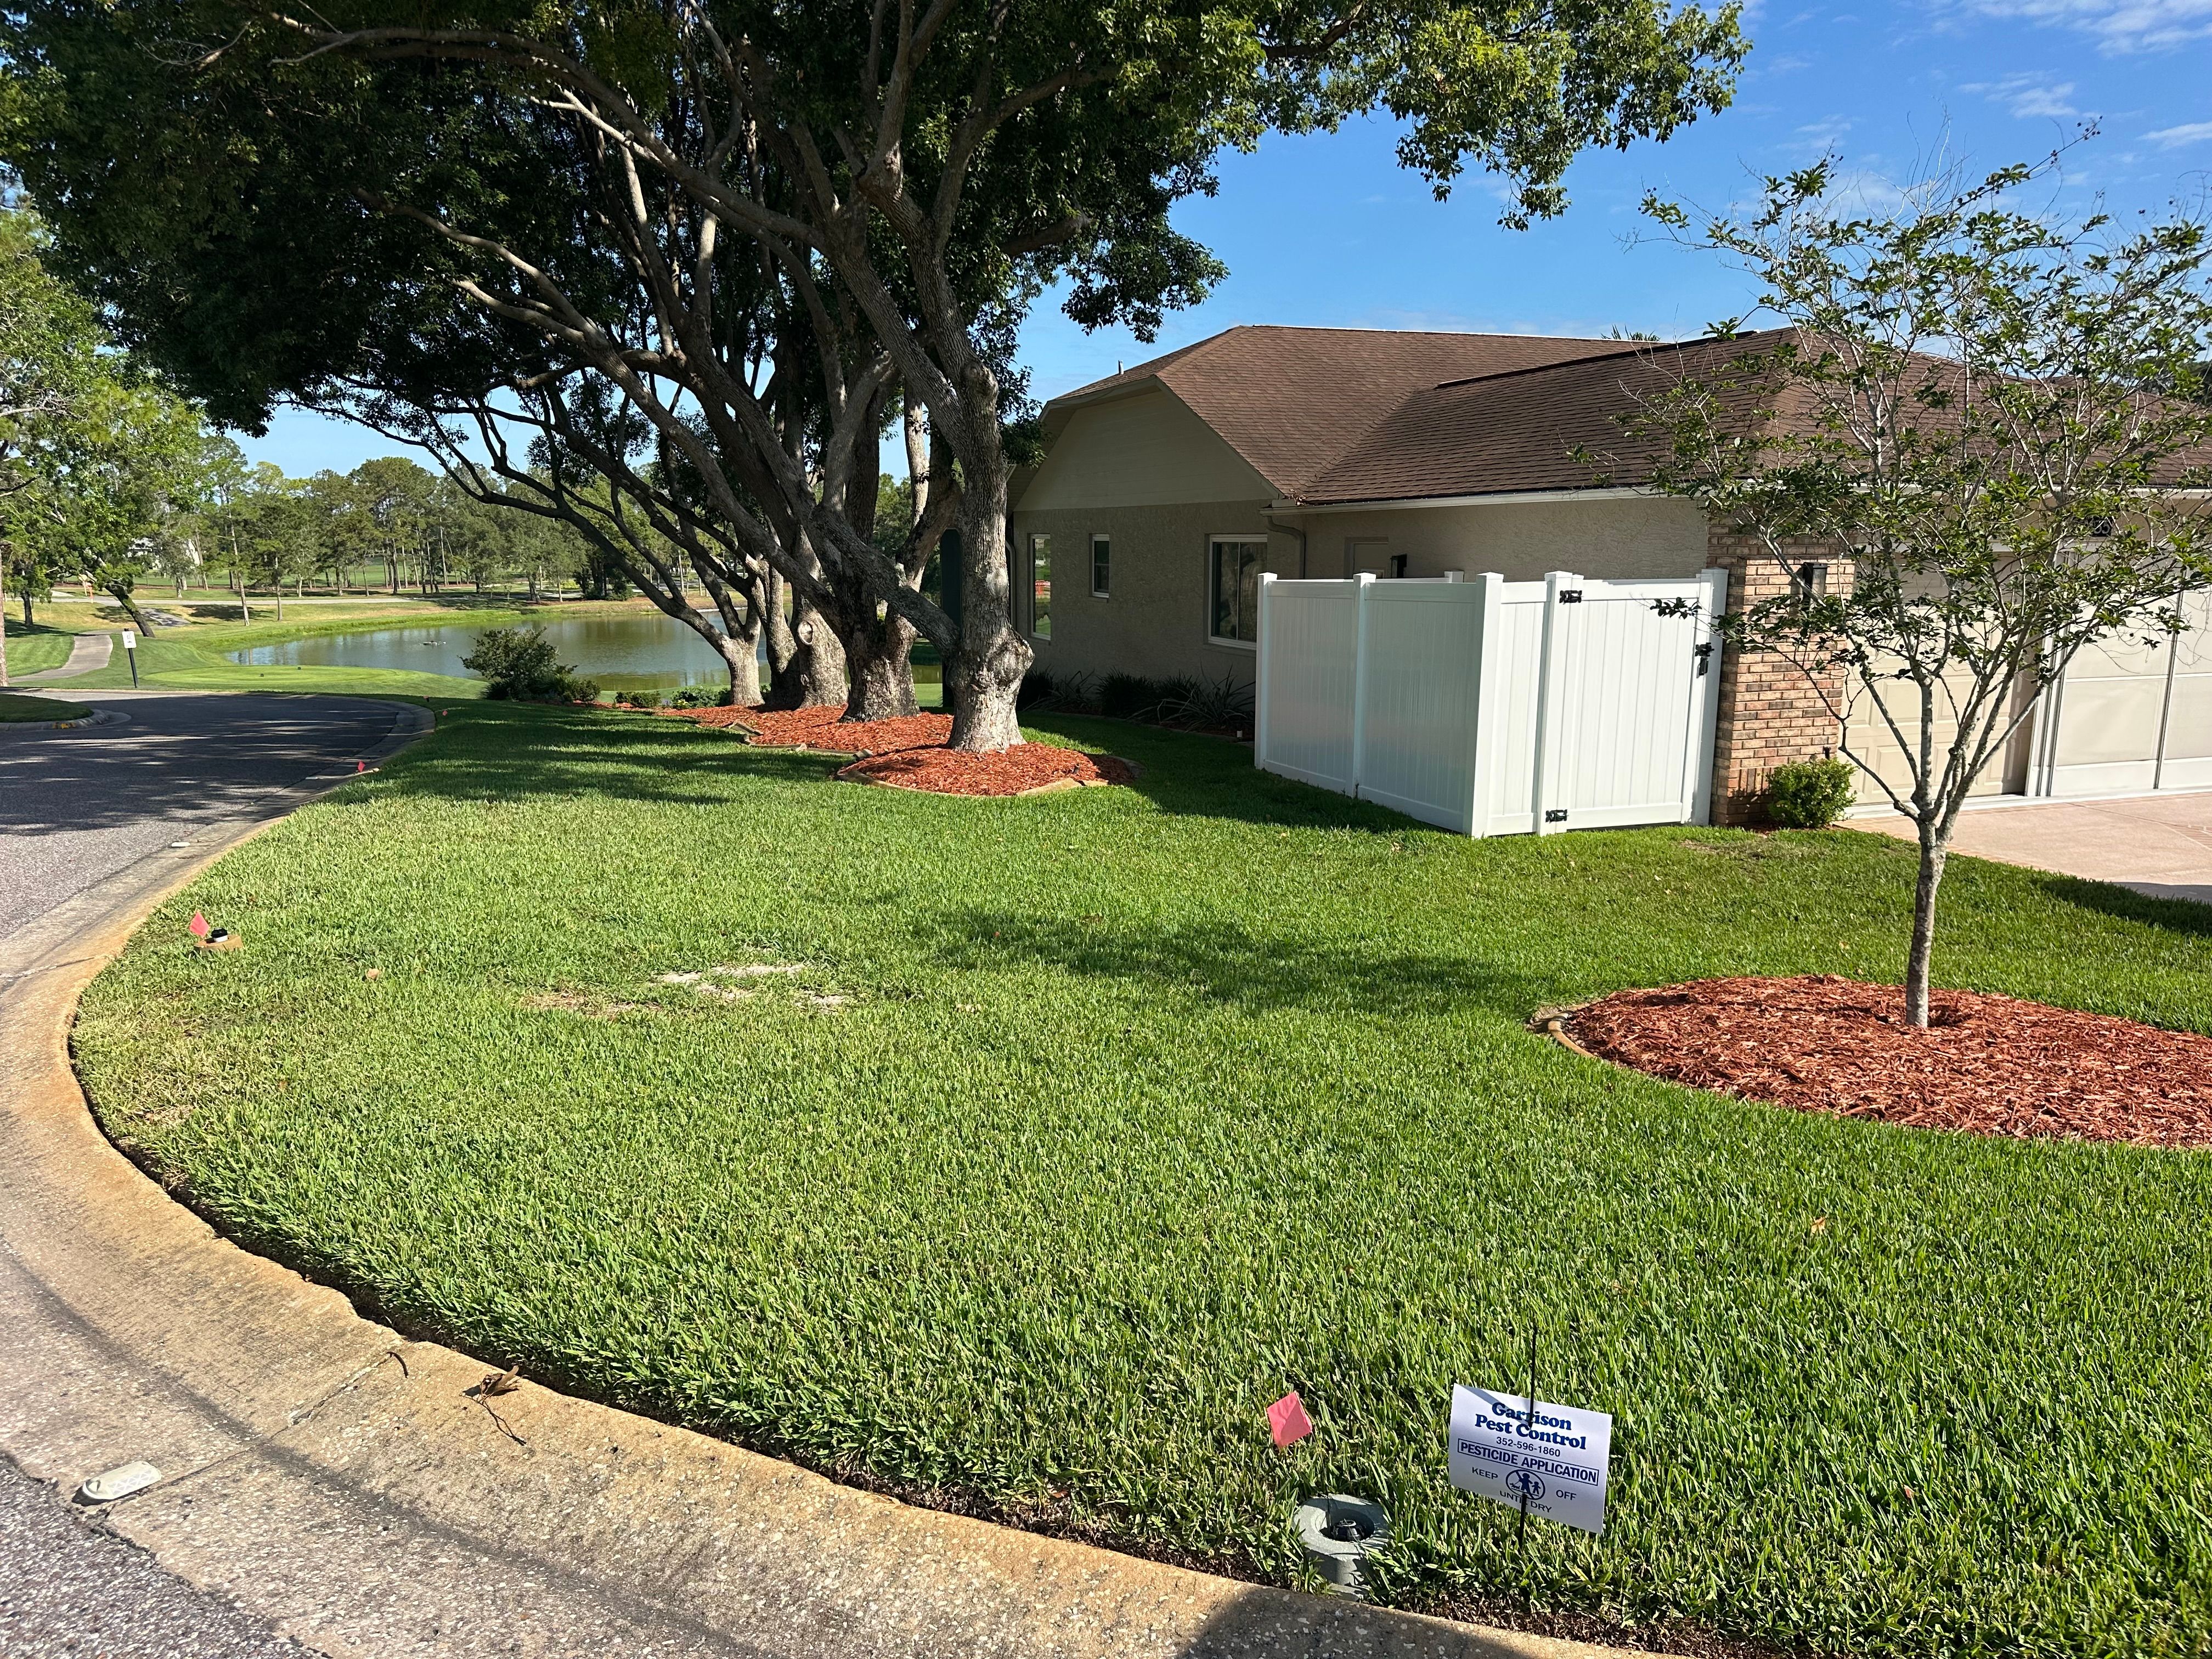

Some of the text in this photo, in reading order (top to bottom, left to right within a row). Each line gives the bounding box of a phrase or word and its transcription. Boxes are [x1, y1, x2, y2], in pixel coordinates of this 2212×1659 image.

[1475, 1413, 1586, 1450] Pest Control
[1492, 1402, 1572, 1430] Garrison
[1496, 1436, 1561, 1457] 352-596-1860
[1460, 1442, 1596, 1483] PESTICIDE APPLICATION
[1472, 1466, 1577, 1500] KEEP OFF
[1499, 1490, 1552, 1513] UNTI DRY
